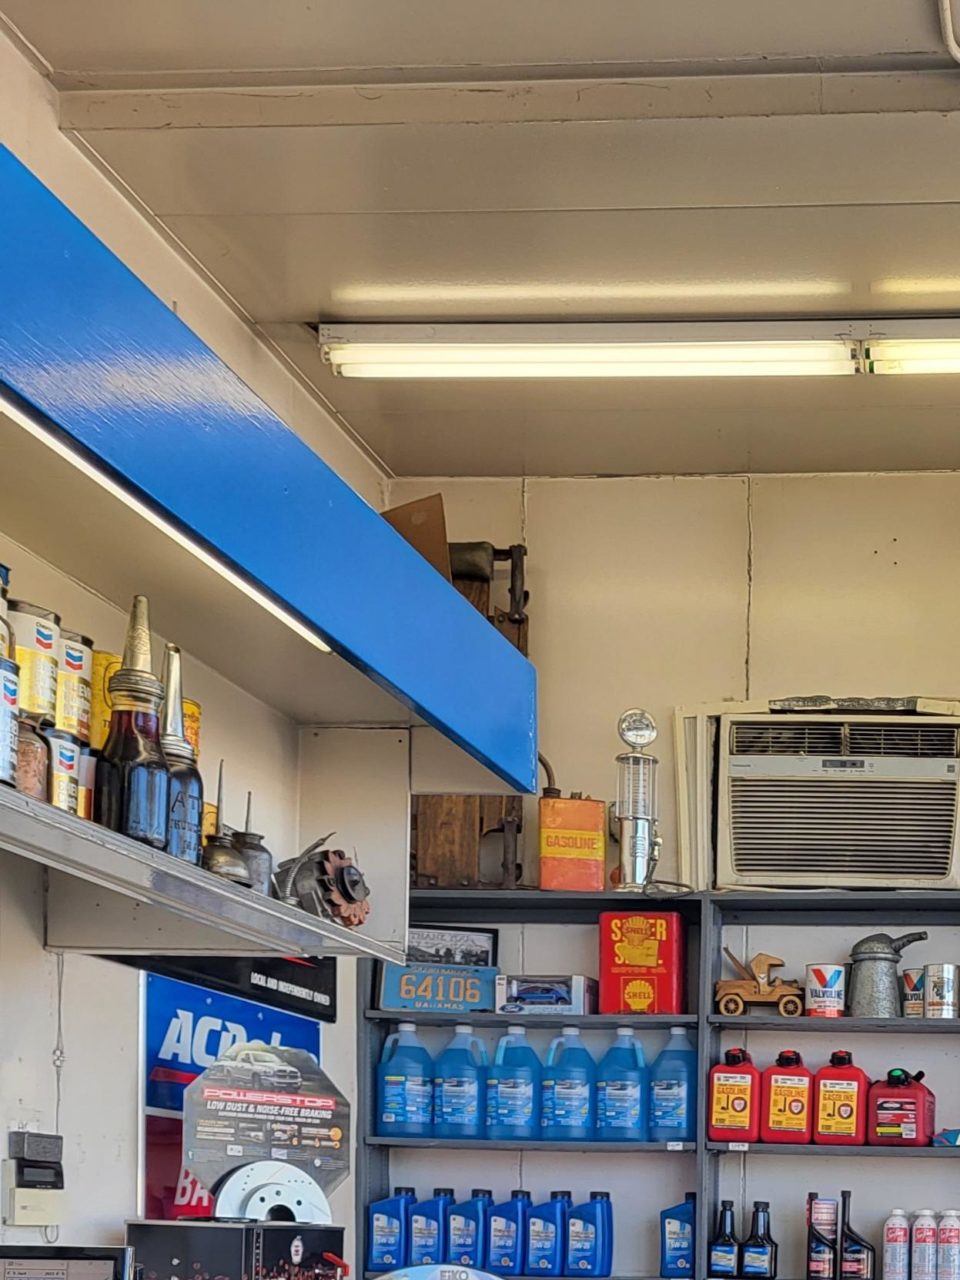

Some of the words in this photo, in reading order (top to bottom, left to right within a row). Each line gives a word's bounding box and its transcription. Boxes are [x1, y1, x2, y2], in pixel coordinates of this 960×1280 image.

[546, 835, 597, 849] GASOLINE
[400, 974, 480, 1003] 64106
[810, 988, 843, 1000] VALVOLINE
[716, 1087, 747, 1096] GASOLINE
[774, 1088, 805, 1098] GASOLINE
[822, 1093, 854, 1101] GASOLINE
[207, 1100, 225, 1110] LOW
[225, 1102, 246, 1112] DUST
[256, 1104, 299, 1117] NOISE-FREE
[300, 1108, 333, 1119] BRAKING
